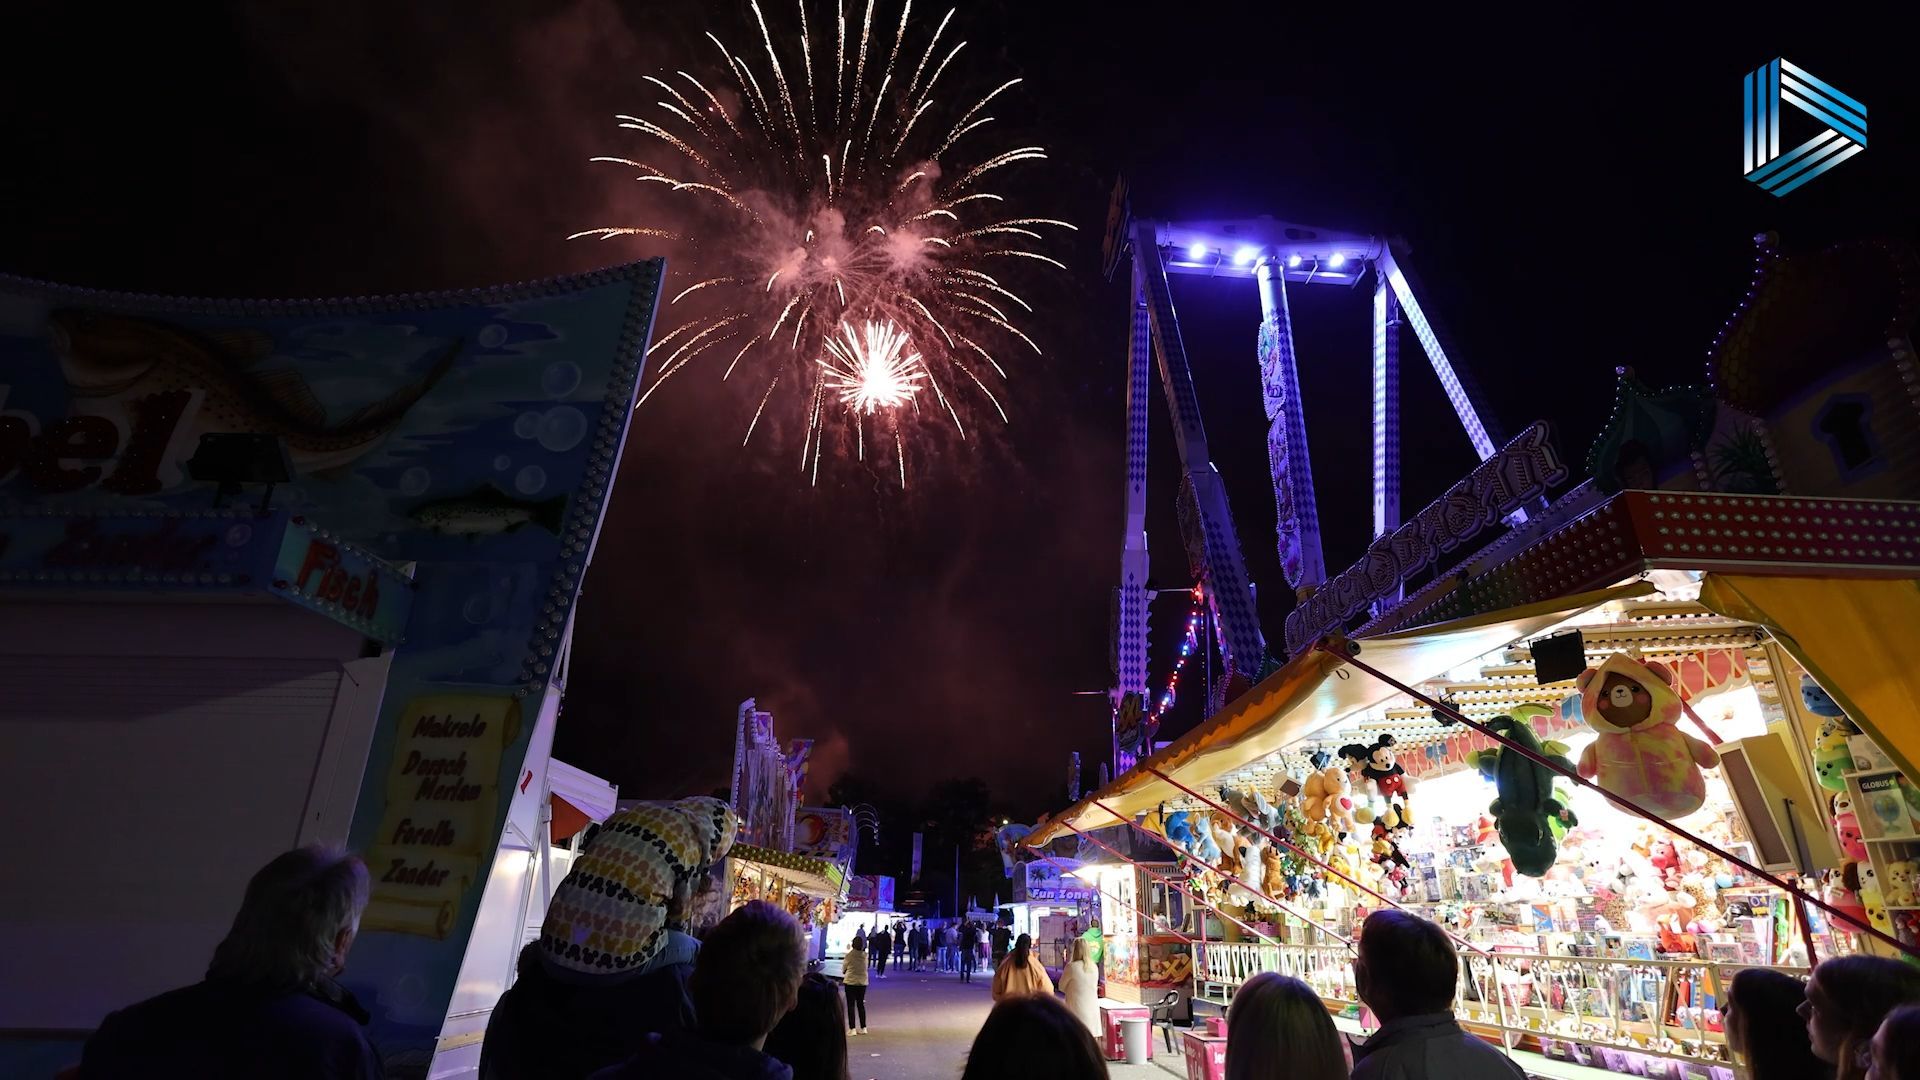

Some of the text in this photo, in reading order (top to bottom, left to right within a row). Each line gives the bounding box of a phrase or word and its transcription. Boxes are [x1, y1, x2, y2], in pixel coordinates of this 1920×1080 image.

[295, 538, 380, 621] Fisch
[412, 713, 487, 738] Makrele
[1861, 779, 1890, 790] GLOBUS
[392, 818, 455, 846] Forelle
[381, 858, 450, 887] Zander
[1032, 888, 1090, 899] Fun Zone
